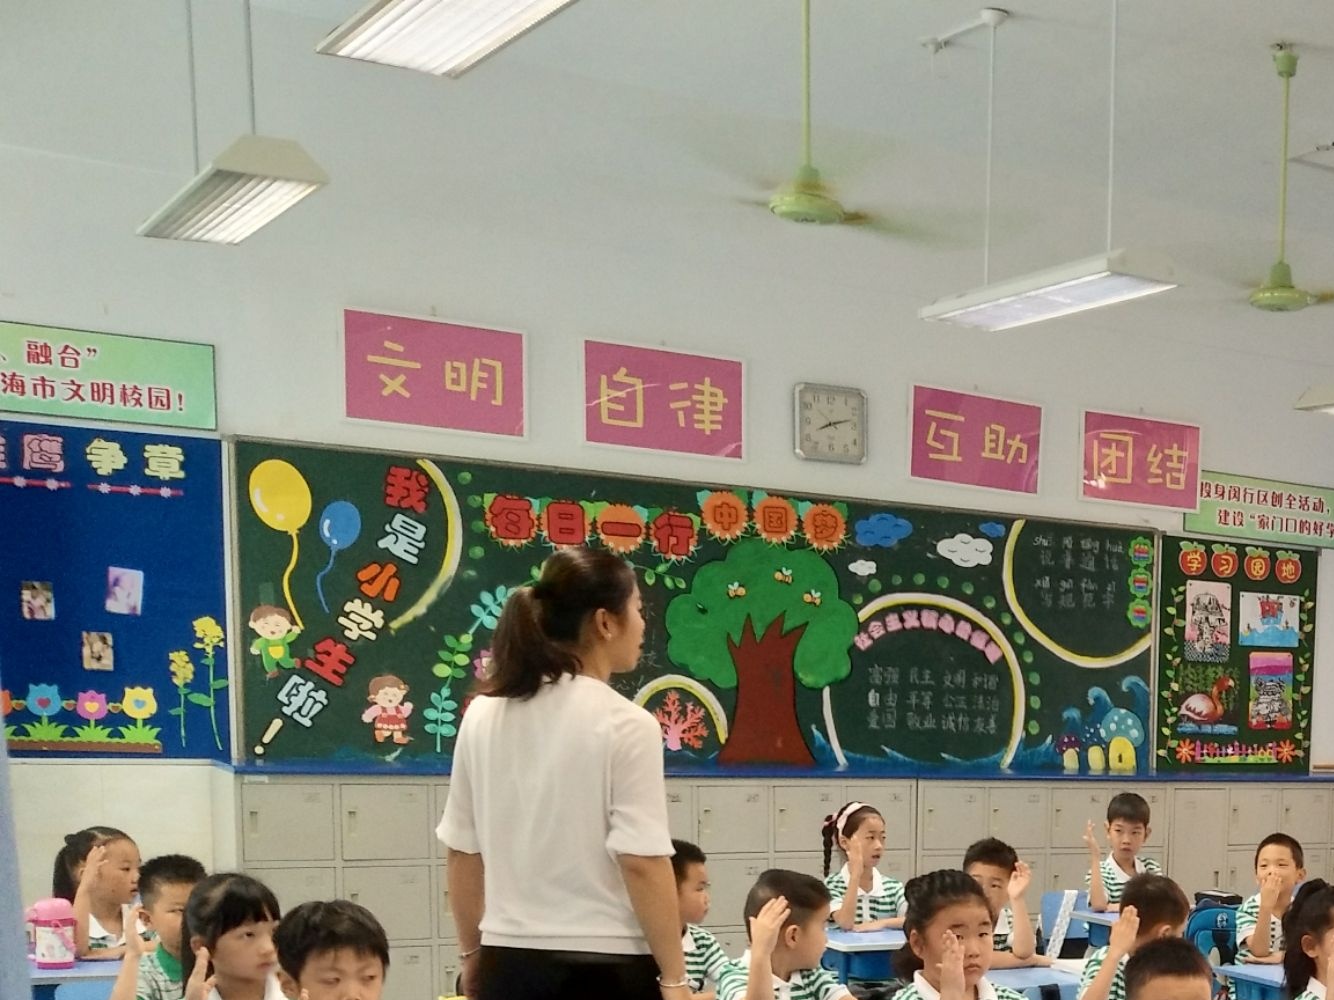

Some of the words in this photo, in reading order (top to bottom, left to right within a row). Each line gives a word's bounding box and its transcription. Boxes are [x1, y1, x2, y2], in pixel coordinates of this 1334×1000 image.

[0, 371, 184, 411] 海市文明校园！
[366, 341, 503, 407] 文明
[600, 367, 728, 435] 自律
[924, 409, 1029, 464] 互助
[1092, 432, 1188, 491] 团结
[488, 494, 695, 557] 每日一行
[1187, 551, 1295, 579] 学习园地
